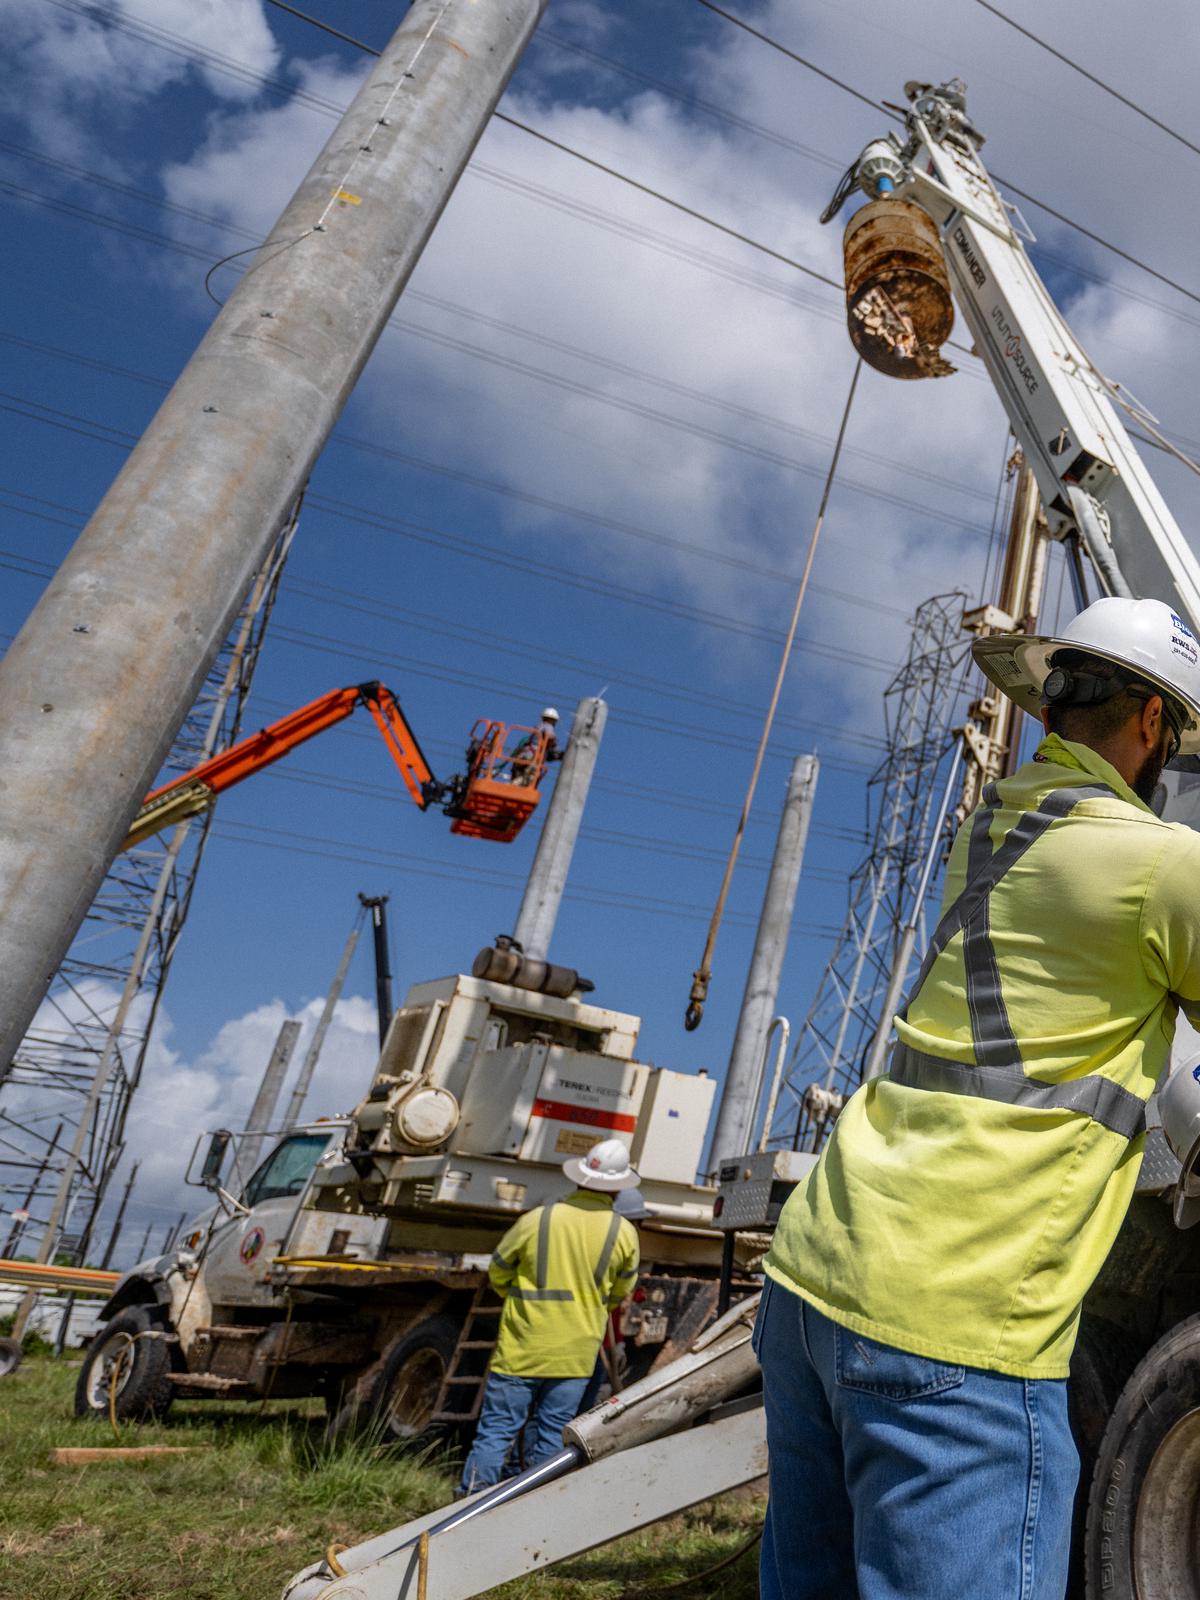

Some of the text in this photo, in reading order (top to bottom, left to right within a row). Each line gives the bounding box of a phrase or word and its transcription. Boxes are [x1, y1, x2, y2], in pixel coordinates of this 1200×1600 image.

[953, 227, 986, 289] COMMANDER
[991, 304, 1039, 395] UTILITY SOURCE
[558, 1079, 592, 1093] TEREX
